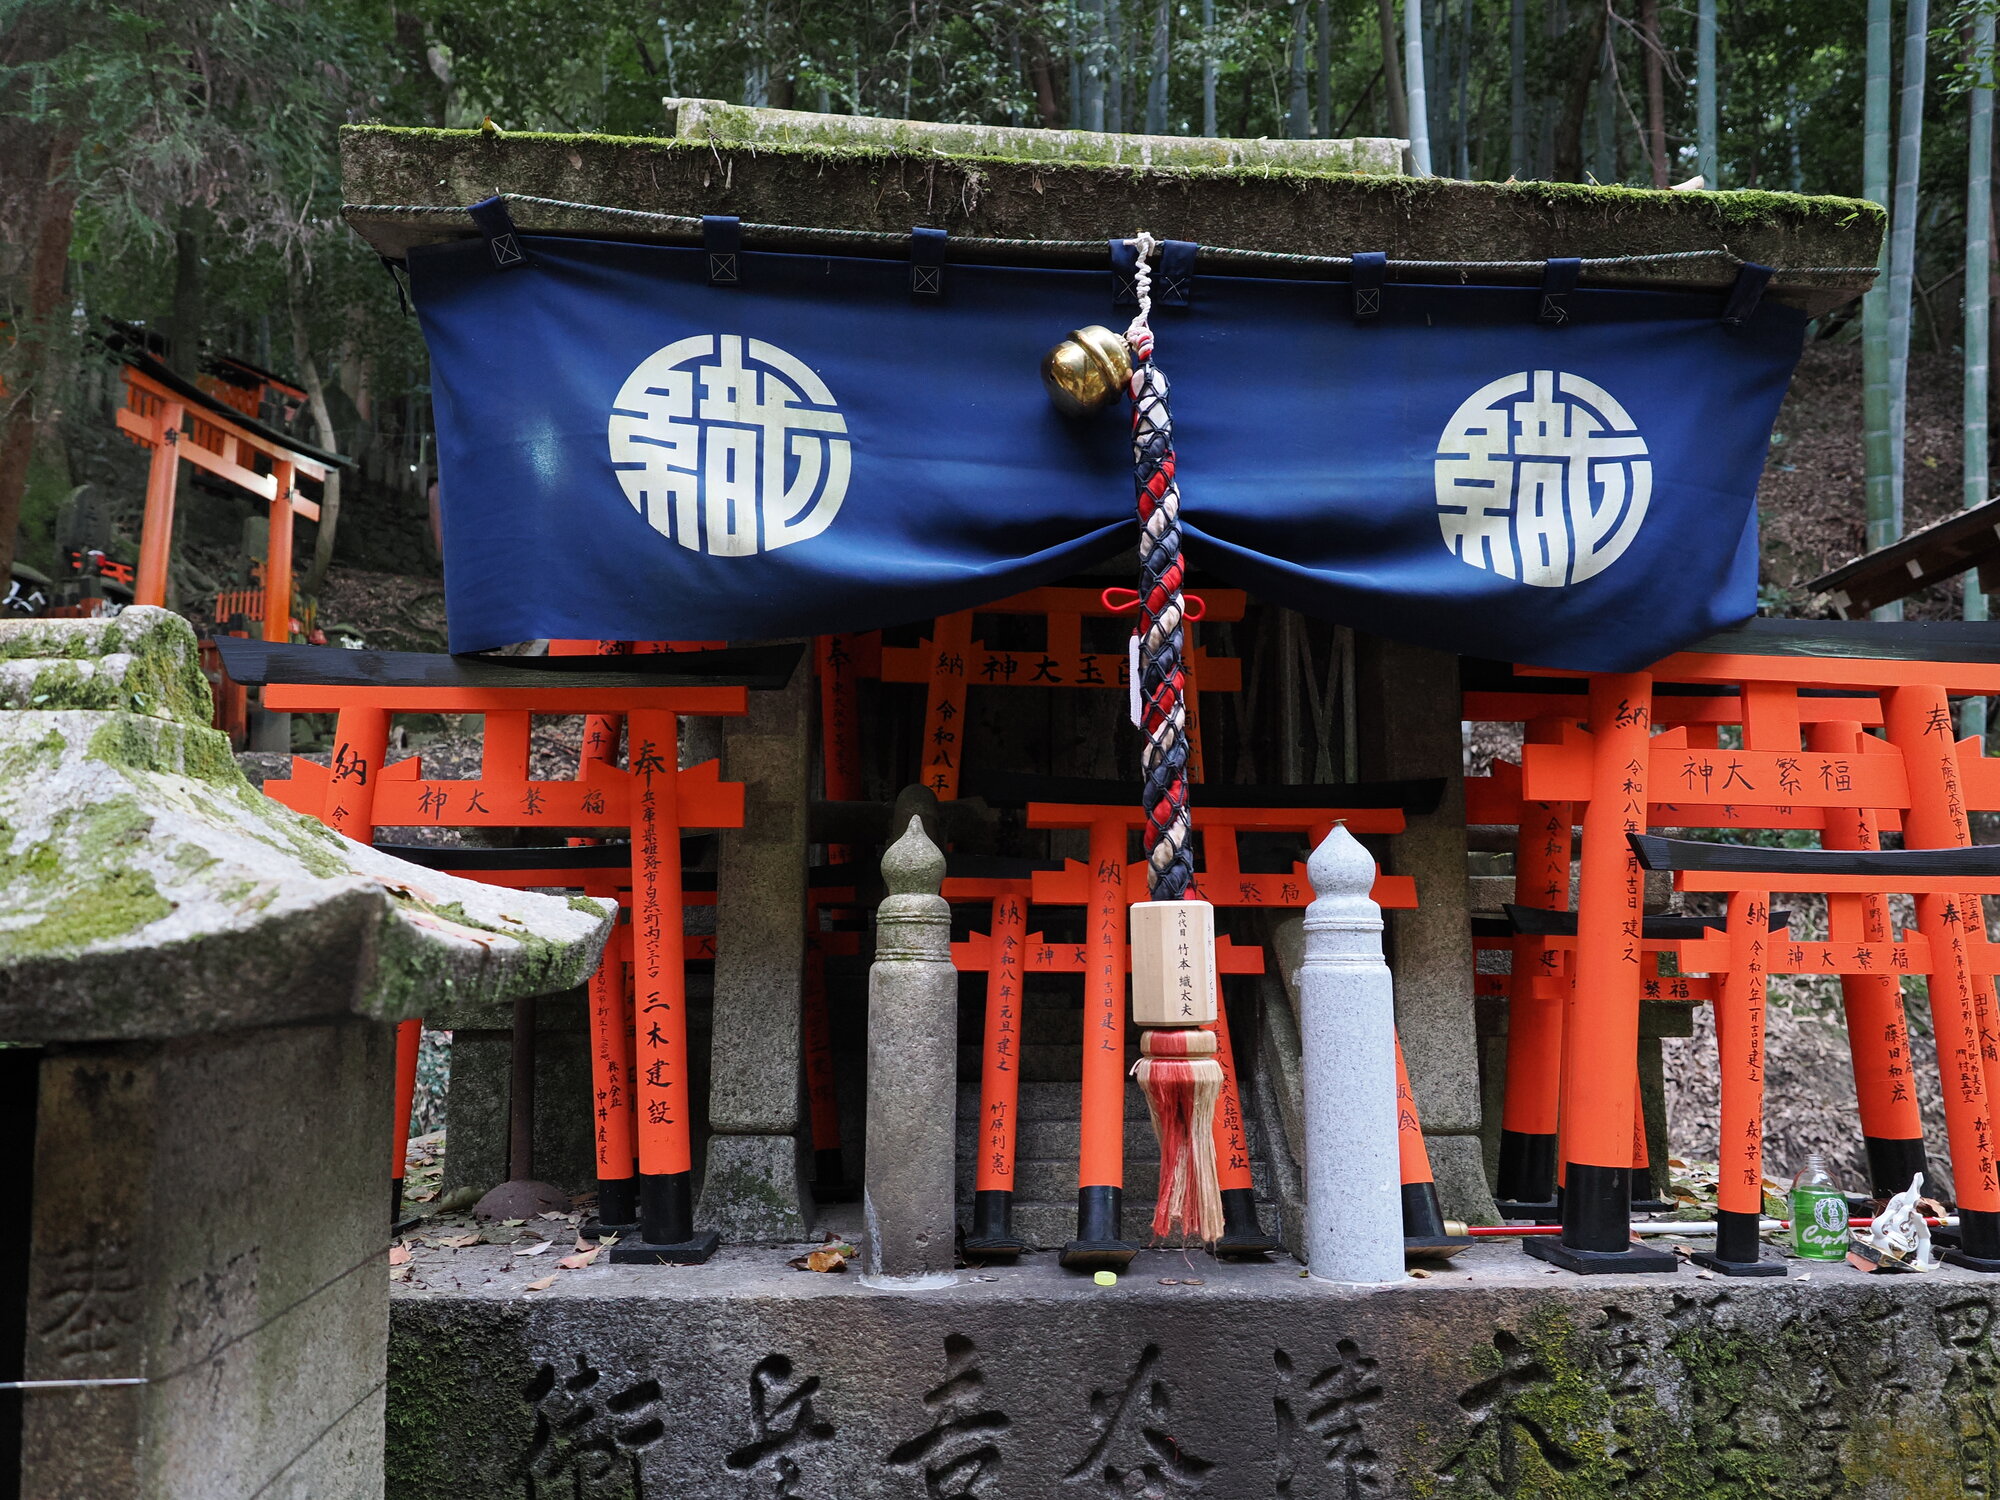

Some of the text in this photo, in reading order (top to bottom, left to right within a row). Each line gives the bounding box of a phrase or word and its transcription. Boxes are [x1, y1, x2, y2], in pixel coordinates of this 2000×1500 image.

[332, 742, 367, 787] 納
[586, 718, 614, 760] 八年
[633, 739, 666, 788] 奉
[929, 651, 963, 793] 納 令和八年
[1923, 702, 1971, 848] 奉 大阪府大阪市中
[1097, 859, 1122, 887] 納
[1543, 816, 1563, 911] 令和八年
[1615, 699, 1650, 964] 納 令和八年一月吉日建之
[1000, 901, 1023, 926] 納
[1747, 902, 1769, 927] 納
[1939, 899, 1962, 935] 奉
[996, 935, 1019, 1072] 令和八年元旦建之
[1177, 909, 1193, 1017] 六代目 竹本織太夫
[643, 991, 675, 1125] 三木建設
[1747, 940, 1763, 1082] 令和八年一月吉日建之
